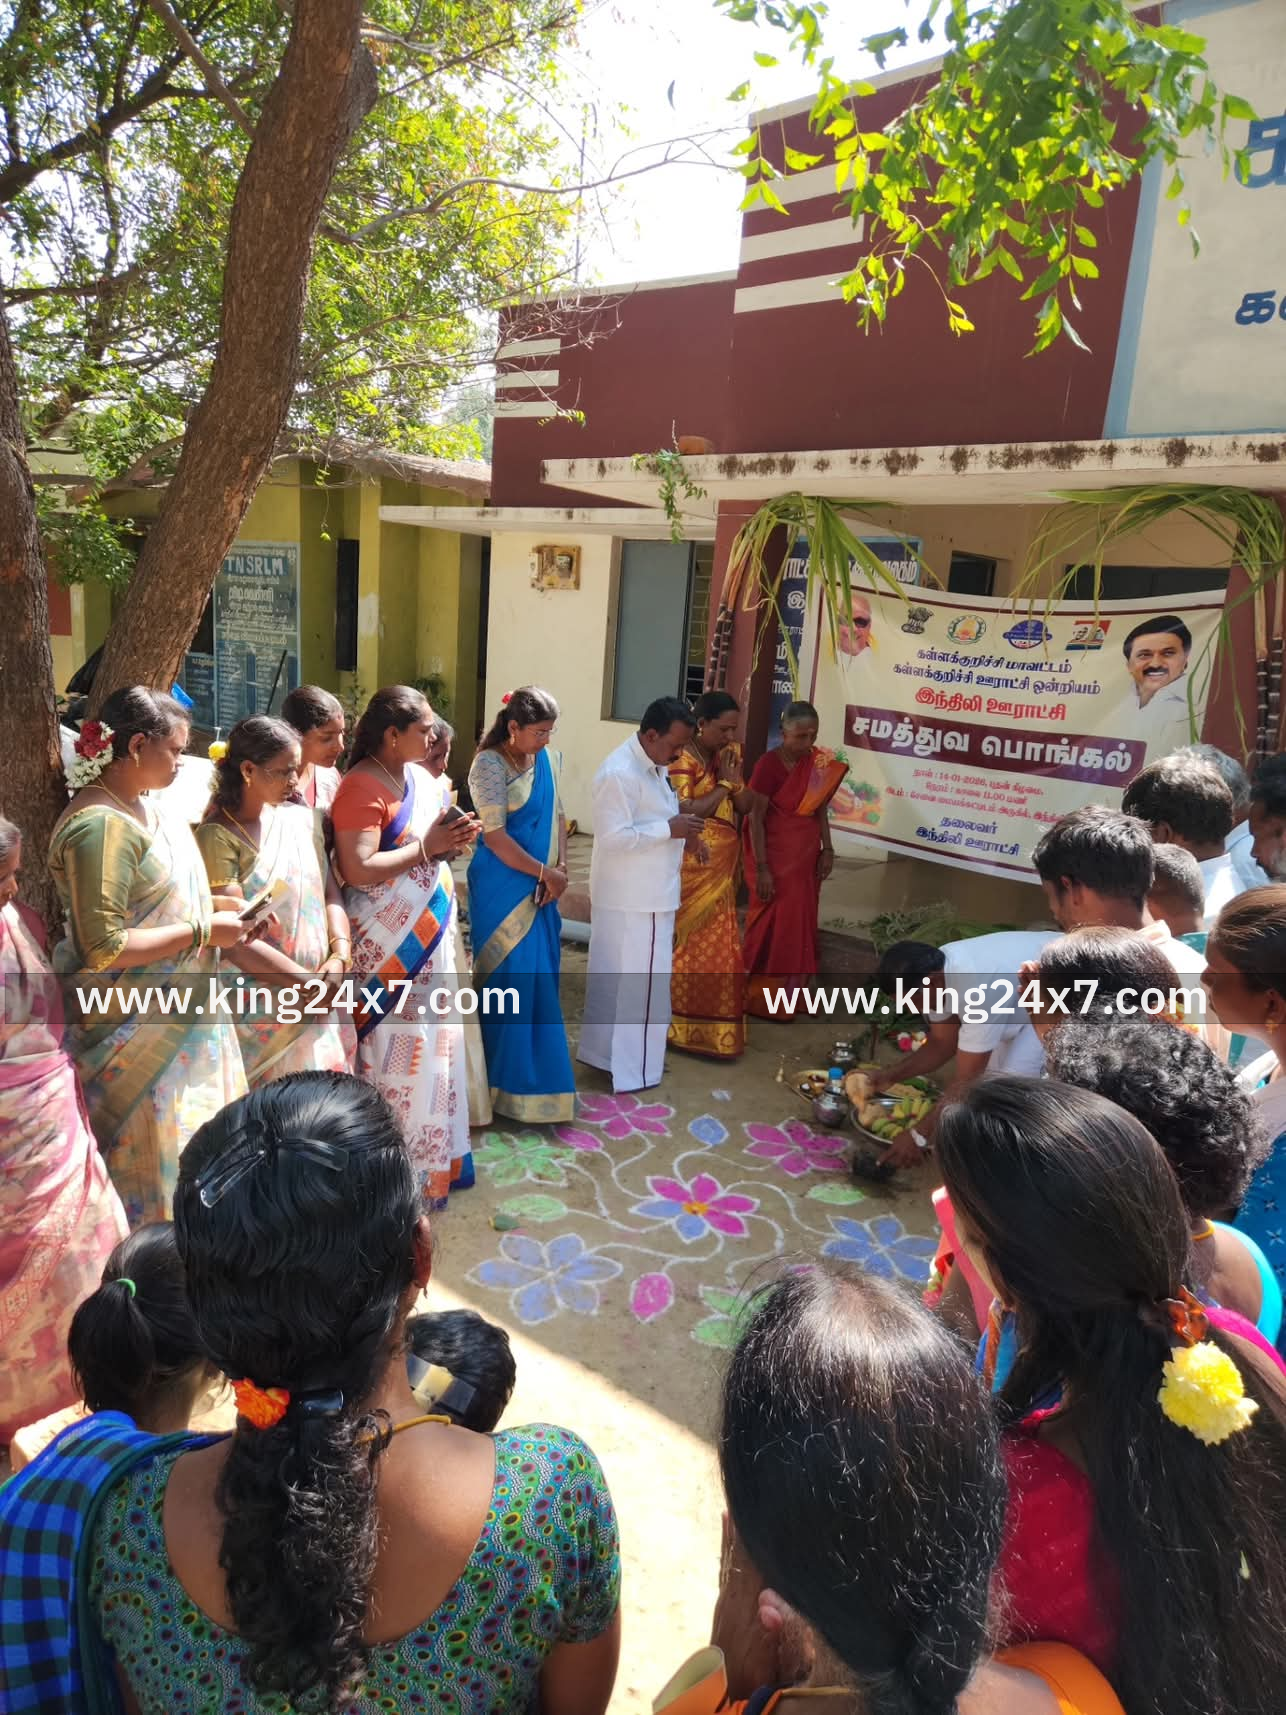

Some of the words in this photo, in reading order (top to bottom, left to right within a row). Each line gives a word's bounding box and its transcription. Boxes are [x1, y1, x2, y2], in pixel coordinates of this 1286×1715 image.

[225, 555, 284, 575] TNSRLM
[916, 646, 1004, 669] கள்ளக்குறிச்சி
[1005, 658, 1072, 674] மாவட்டம்
[892, 661, 973, 684] கள்ளக்குறிச்சி
[976, 674, 1029, 690] ஊராட்சி
[1033, 677, 1100, 696] ஒன்றியம்
[915, 686, 982, 712] இந்திலி
[986, 698, 1066, 721] ஊராட்சி
[852, 715, 969, 757] சமத்துவ
[981, 735, 1131, 773] பொங்கல்
[915, 825, 962, 844] இந்திலி
[965, 837, 1020, 856] ஊராட்சி
[940, 816, 999, 834] தலைவர்
